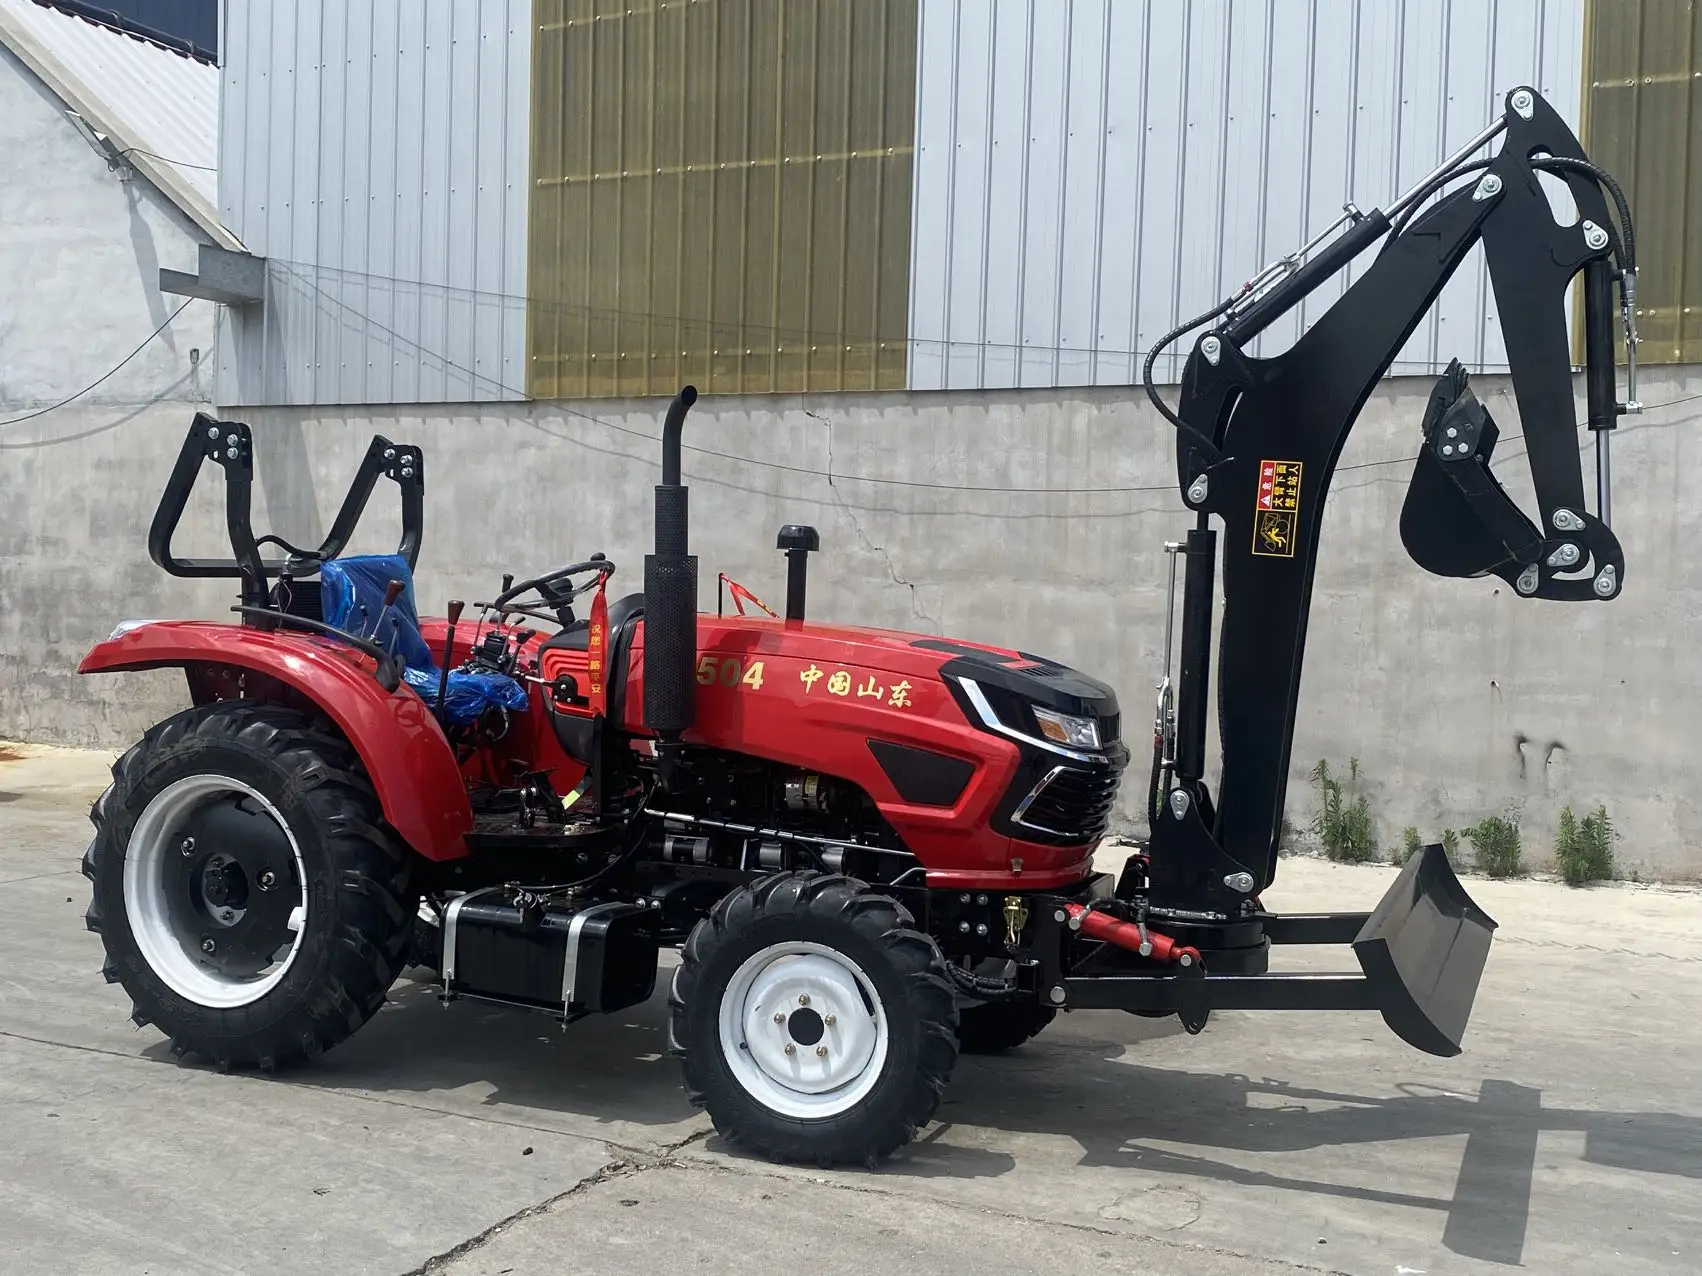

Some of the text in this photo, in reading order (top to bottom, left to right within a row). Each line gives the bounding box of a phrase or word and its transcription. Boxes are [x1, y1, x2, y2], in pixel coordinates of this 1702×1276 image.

[1262, 467, 1274, 491] 危险
[1285, 465, 1299, 507] 禁止站人
[696, 656, 765, 690] 504
[800, 664, 912, 708] 中国山东
